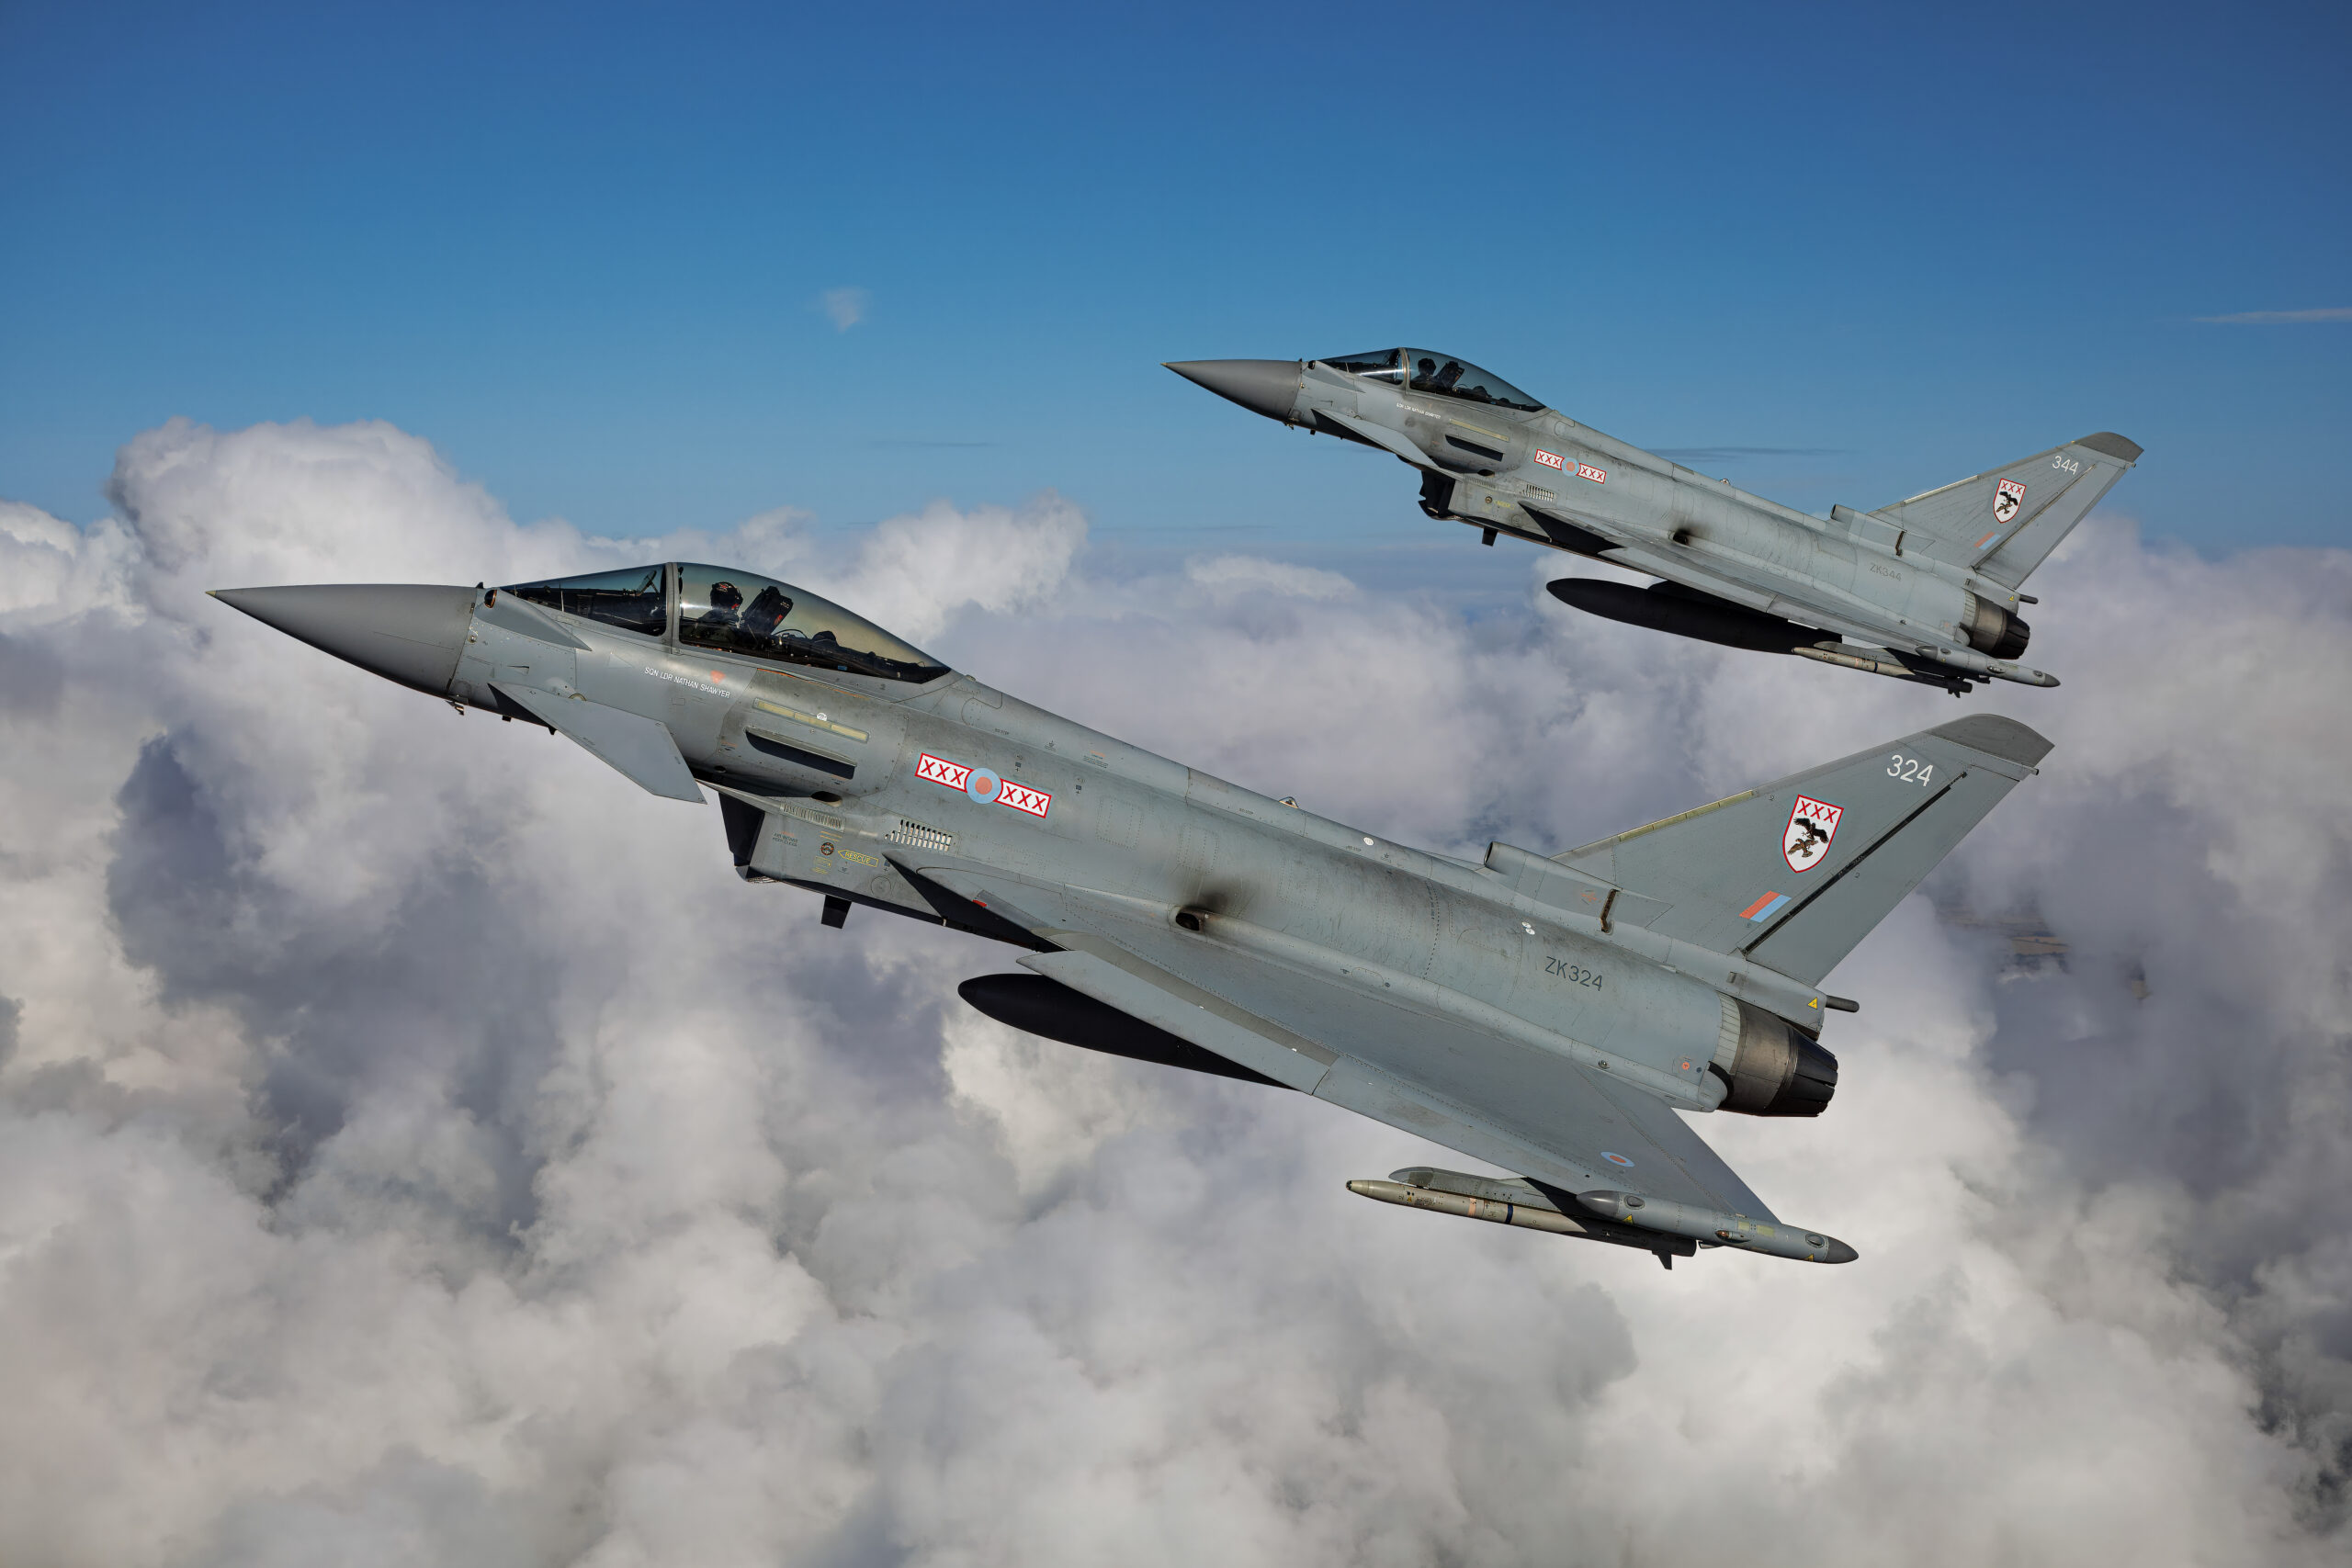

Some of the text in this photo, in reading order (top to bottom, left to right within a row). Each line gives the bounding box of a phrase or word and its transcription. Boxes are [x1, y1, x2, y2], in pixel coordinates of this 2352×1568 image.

[1537, 452, 1604, 480] XXX XXX
[2052, 455, 2079, 475] 344
[2001, 480, 2023, 494] XXX
[644, 666, 730, 698] SQN LDR NATHAN SHAWYER
[1886, 754, 1934, 787] 324
[921, 759, 1046, 812] XXX XXX
[1797, 800, 1838, 823] XXX
[844, 852, 871, 863] RESCUE
[1544, 955, 1602, 992] ZK324
